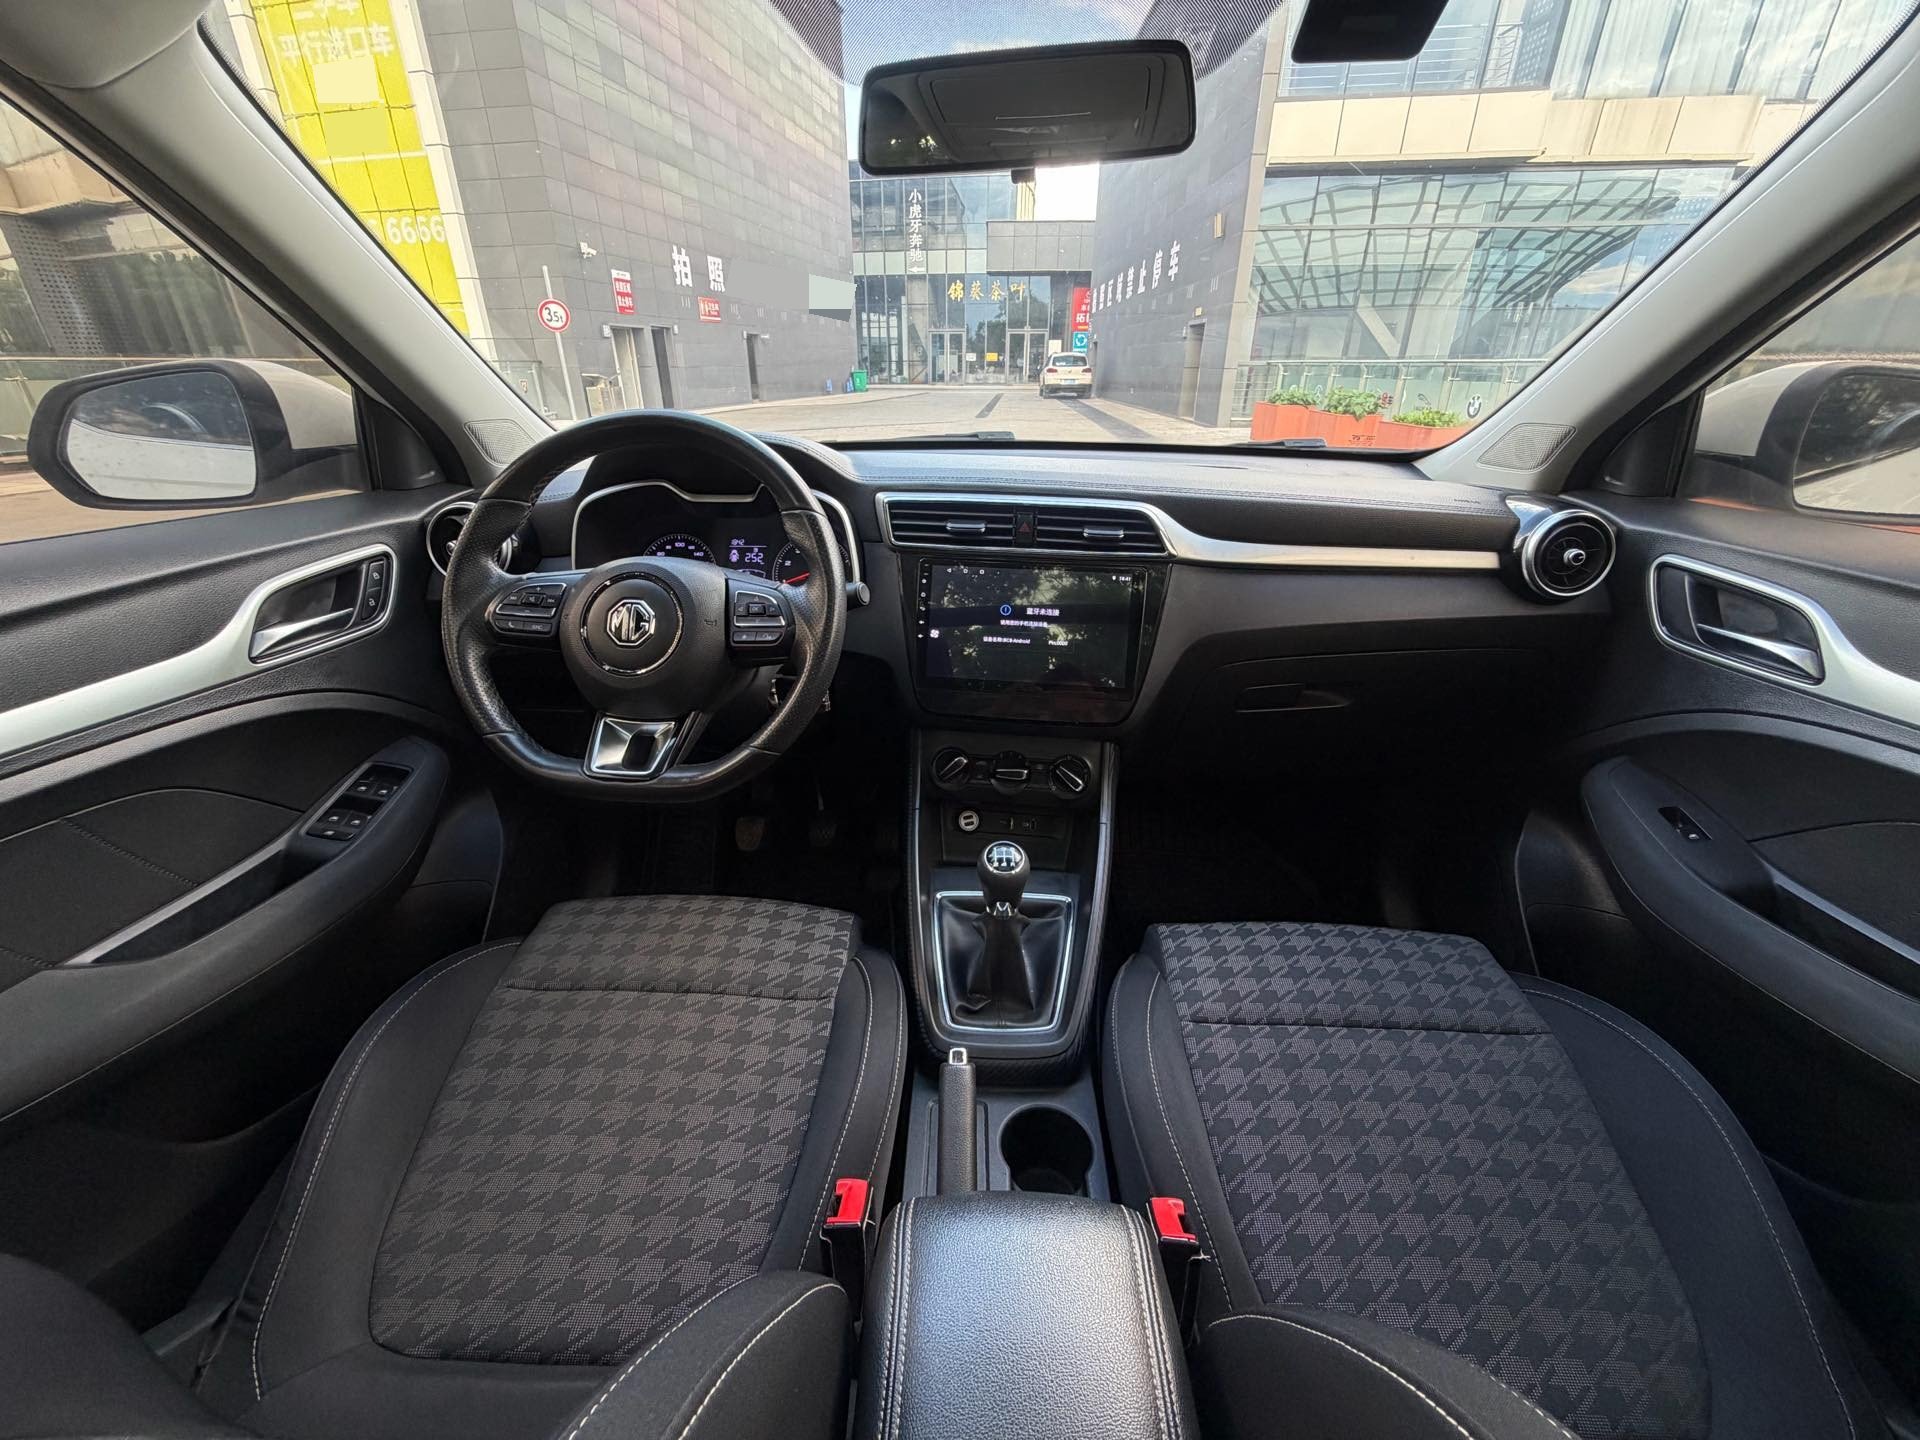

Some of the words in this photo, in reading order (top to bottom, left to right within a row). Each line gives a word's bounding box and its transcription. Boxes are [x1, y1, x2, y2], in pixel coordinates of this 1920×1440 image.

[908, 188, 924, 262] 小虎牙奔驰
[672, 244, 726, 292] 拍照
[947, 279, 1026, 302] 锦葵茶叶
[611, 603, 650, 641] MG
